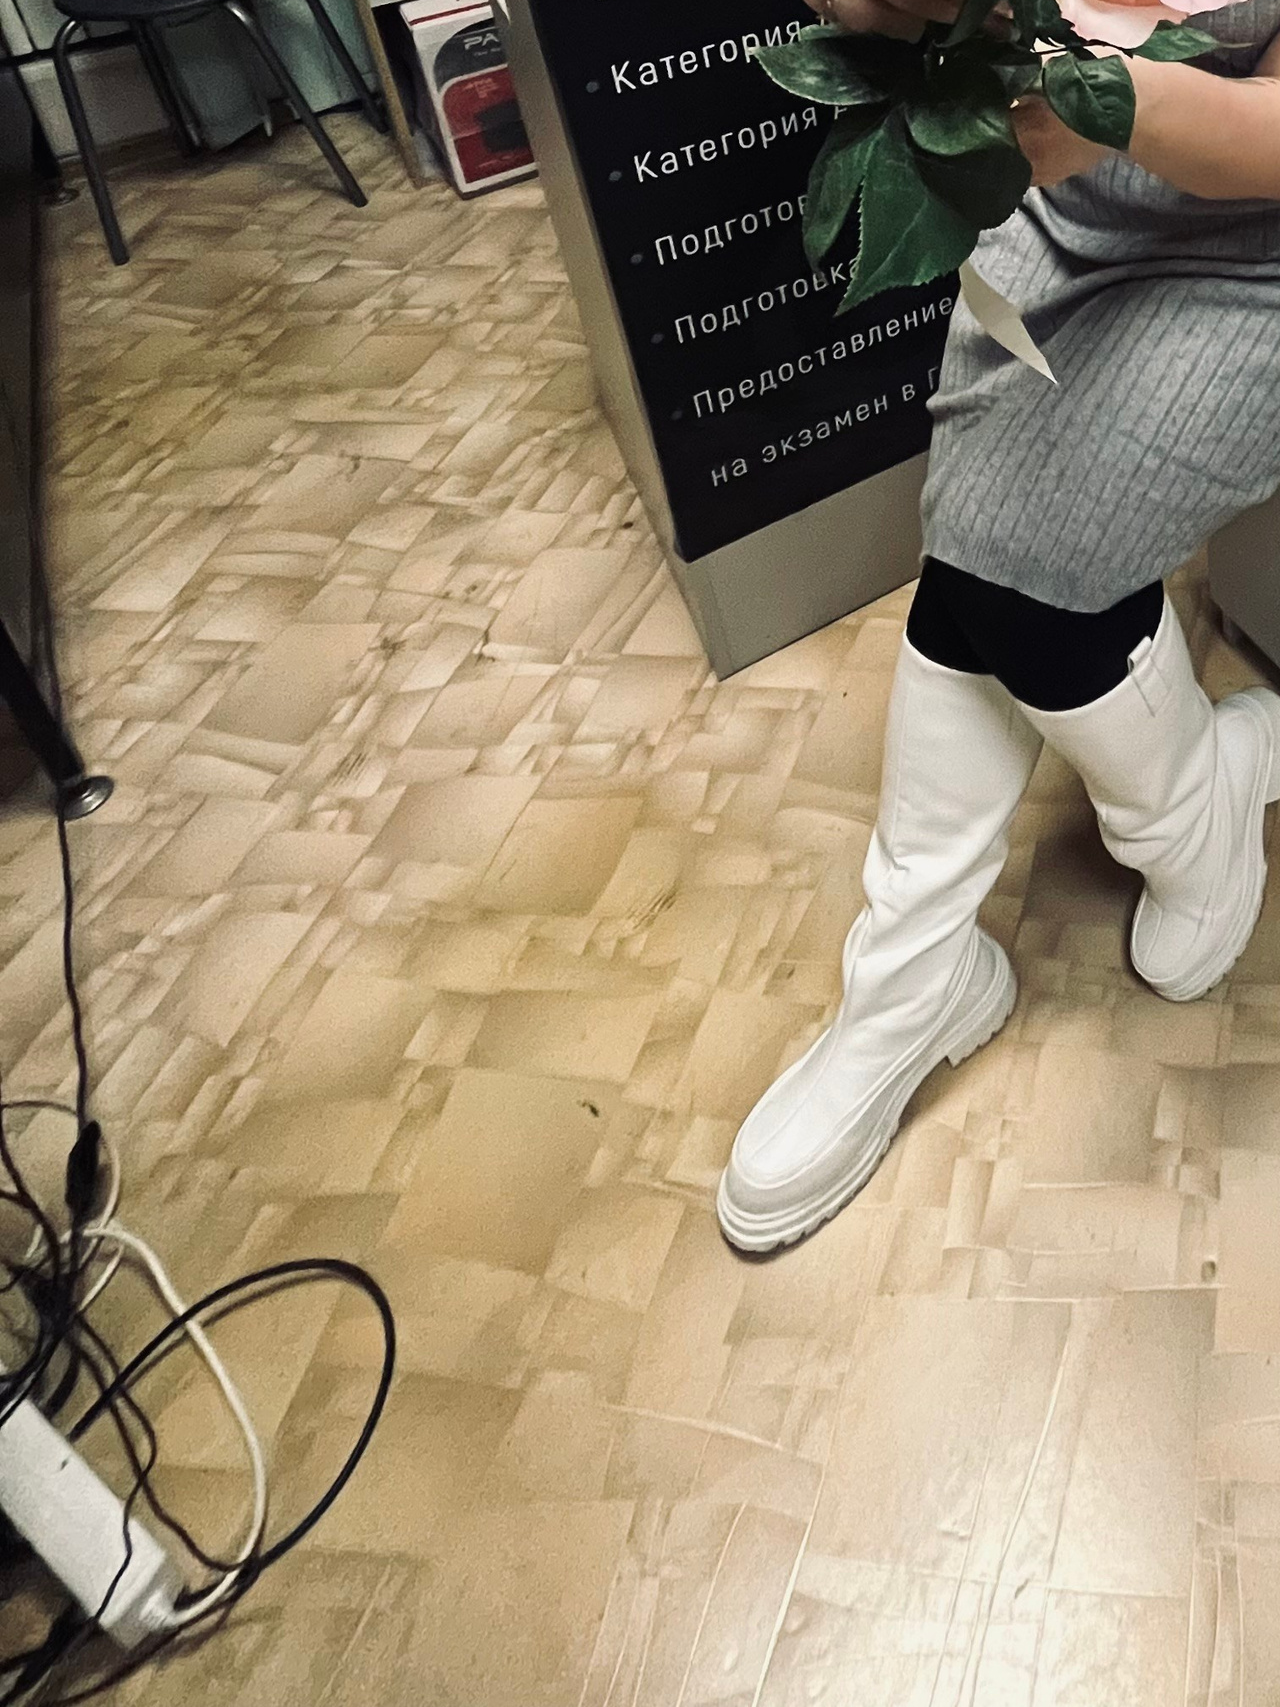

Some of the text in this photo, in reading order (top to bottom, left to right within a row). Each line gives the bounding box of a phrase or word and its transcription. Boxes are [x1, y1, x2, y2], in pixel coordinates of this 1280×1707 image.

[611, 20, 801, 94] Категория
[634, 106, 818, 182] Категория
[693, 296, 952, 418] Предоставление
[711, 457, 748, 487] на
[762, 394, 888, 464] экзамен
[901, 382, 916, 402] в
